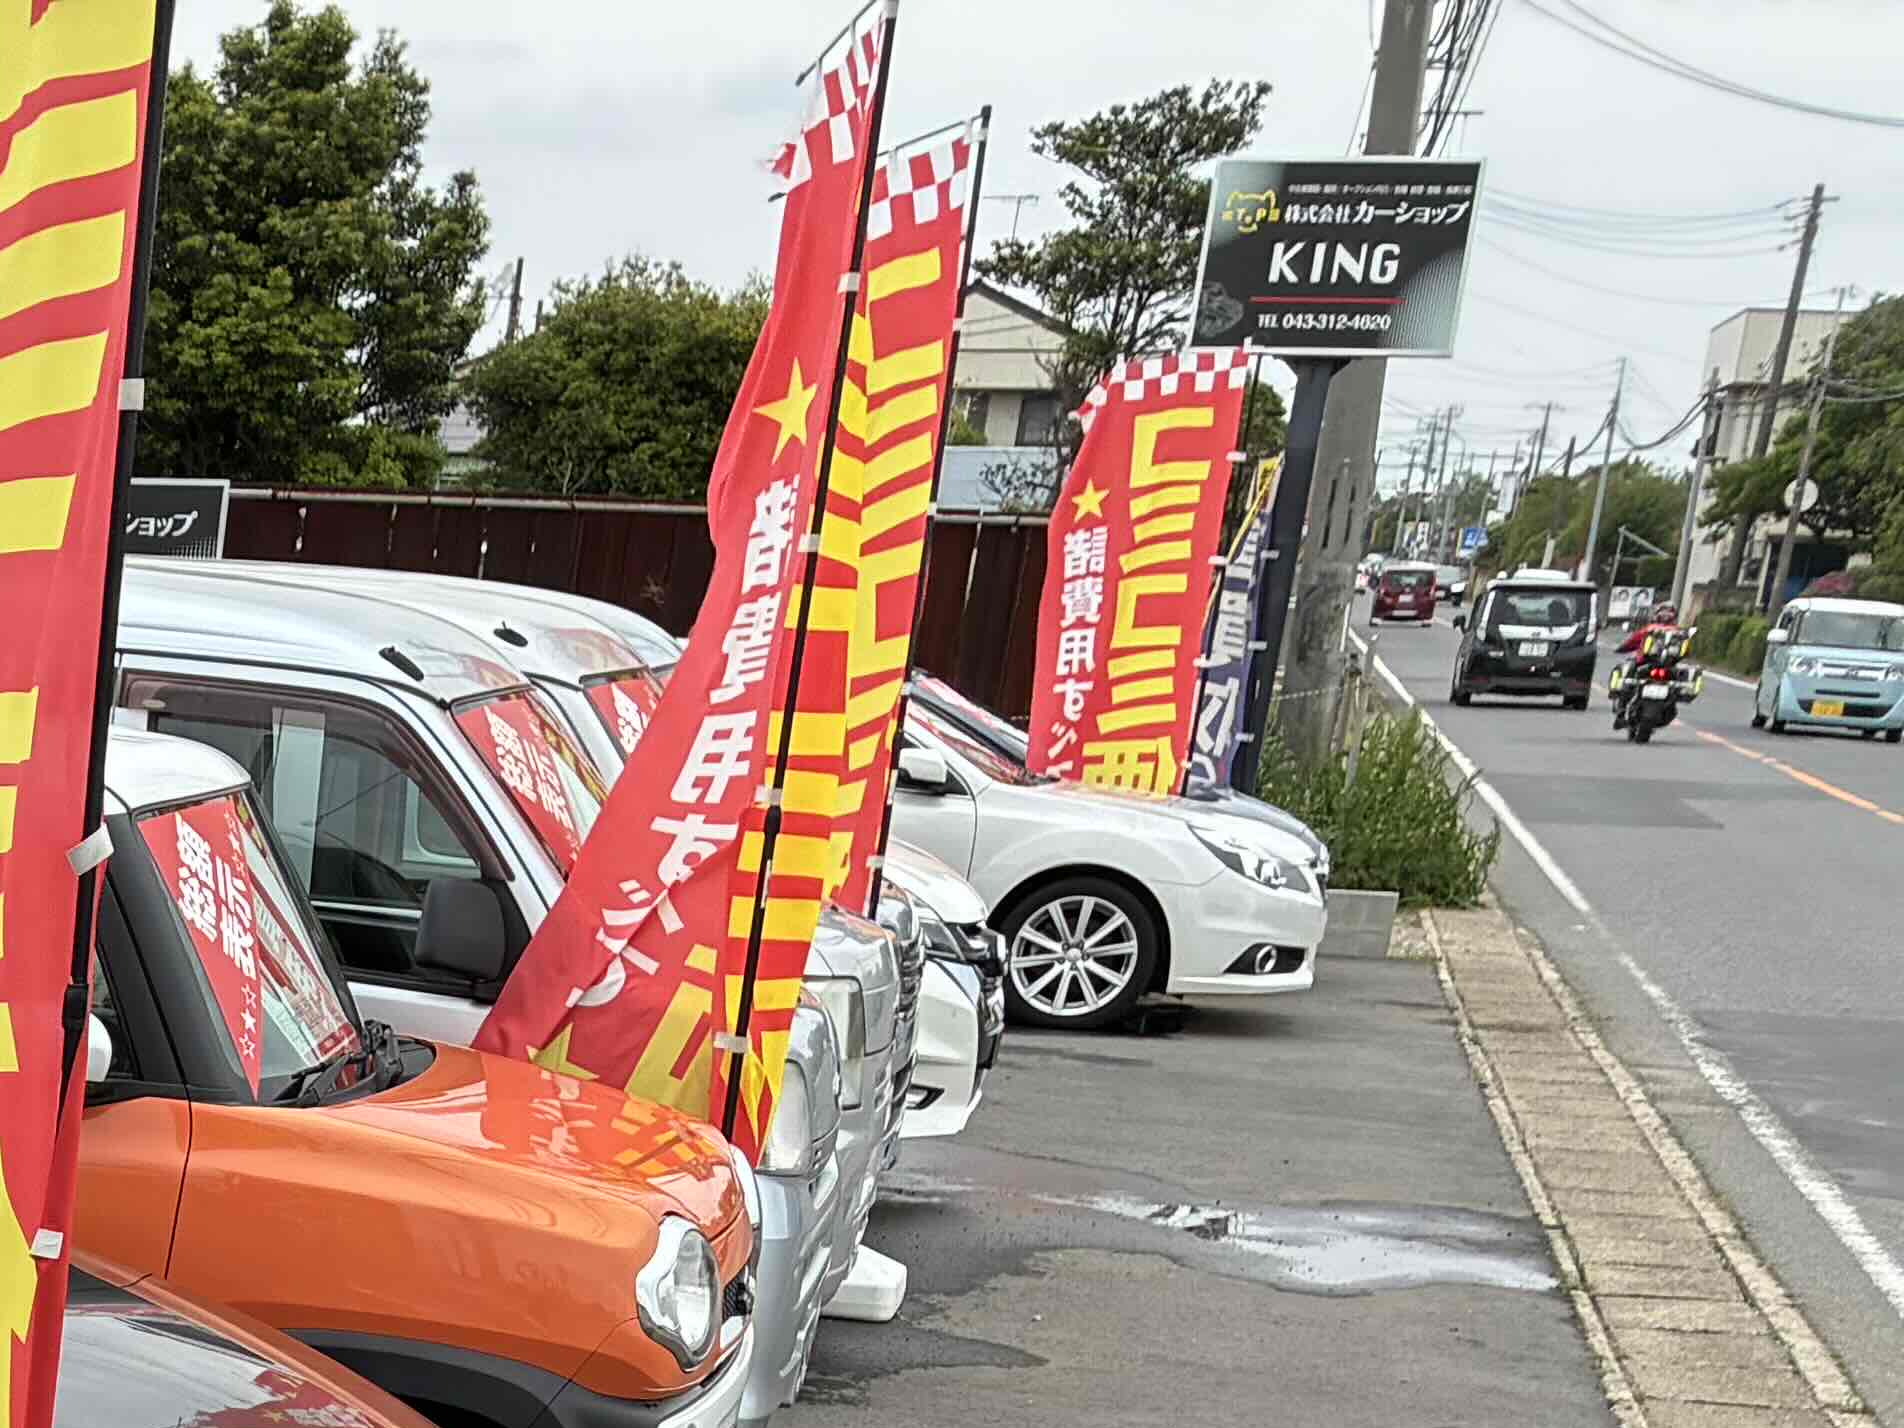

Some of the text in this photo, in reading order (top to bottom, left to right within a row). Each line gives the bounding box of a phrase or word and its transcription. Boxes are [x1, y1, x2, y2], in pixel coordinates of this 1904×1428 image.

[1284, 200, 1471, 225] 株式会社カーショップ
[1268, 242, 1401, 285] KING
[1258, 313, 1392, 331] TEL 043-312-4620
[174, 811, 217, 944] 総額
[215, 855, 258, 981] 表示
